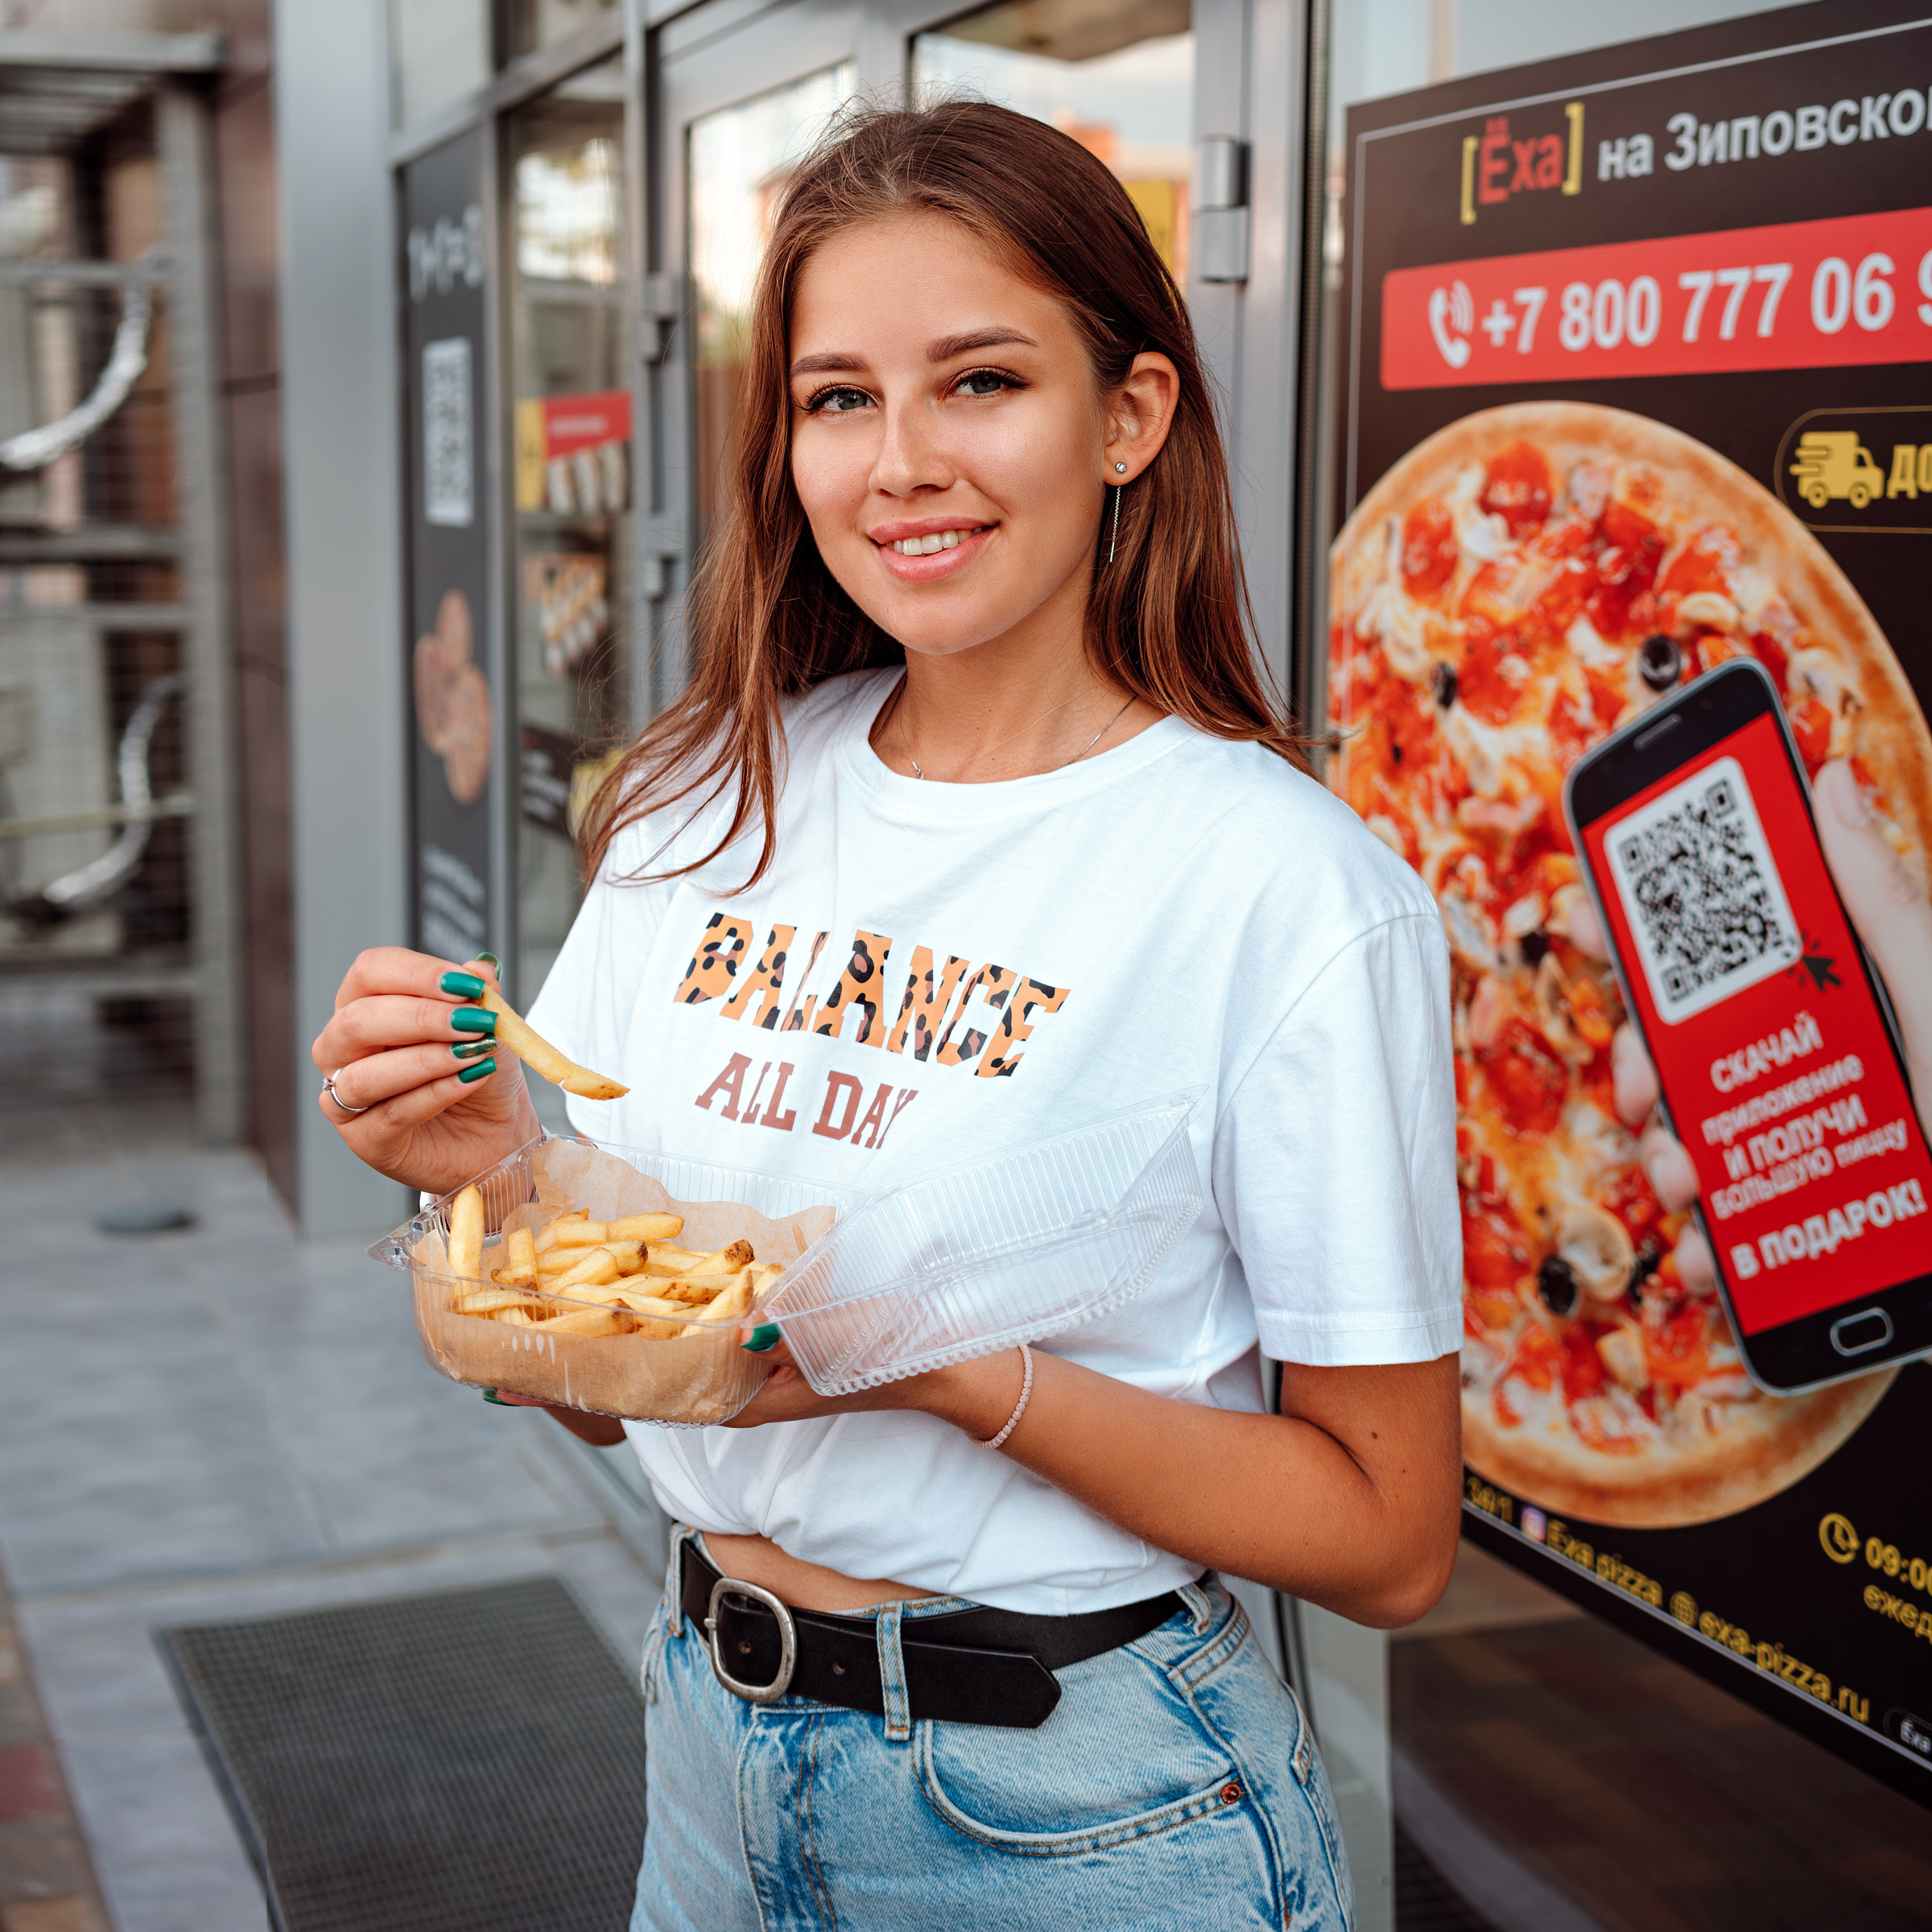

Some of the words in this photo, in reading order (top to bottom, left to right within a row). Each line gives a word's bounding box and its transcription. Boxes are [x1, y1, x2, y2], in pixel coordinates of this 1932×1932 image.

[1598, 134, 1653, 180] на
[1665, 85, 1932, 171] Зиповско
[1482, 287, 1547, 353] +7
[1559, 275, 1662, 351] 800
[1679, 263, 1792, 342] 777
[1810, 252, 1896, 334] 06
[673, 912, 1071, 1077] BALANCE
[1711, 1011, 1824, 1092] СКАЧАЙ
[695, 1052, 797, 1132] ALL
[812, 1070, 919, 1150] DAY
[1701, 1055, 1864, 1146] приложение
[1746, 1093, 1868, 1170] ПОЛУЧИ
[1757, 1178, 1928, 1269] ПОДАРОК!
